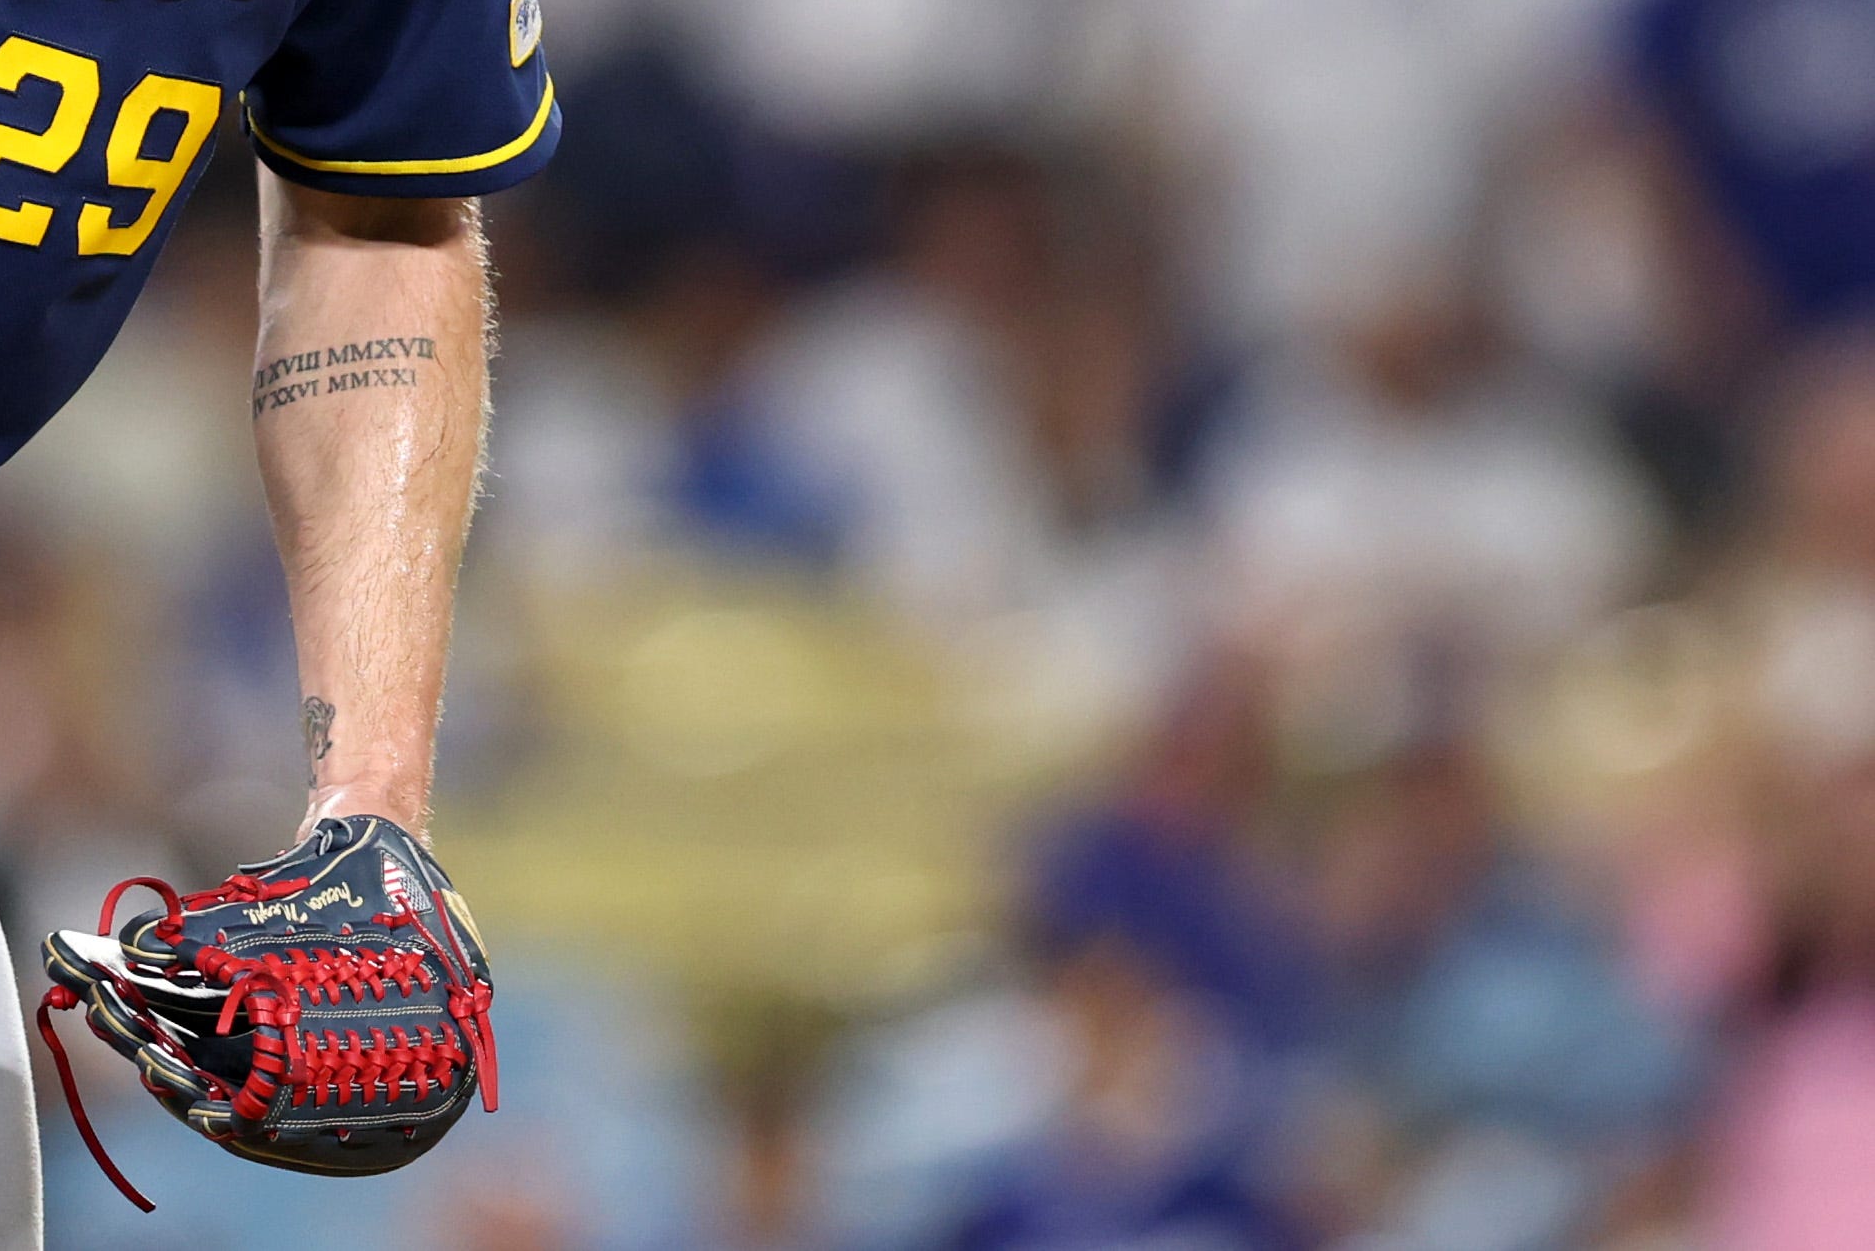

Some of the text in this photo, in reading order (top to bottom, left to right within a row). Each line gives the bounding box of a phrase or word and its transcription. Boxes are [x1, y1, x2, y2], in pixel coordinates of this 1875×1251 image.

[269, 350, 321, 385] XVIII
[326, 337, 435, 367] MMXVII
[269, 379, 319, 409] XXVI
[327, 368, 417, 394] MMXXI
